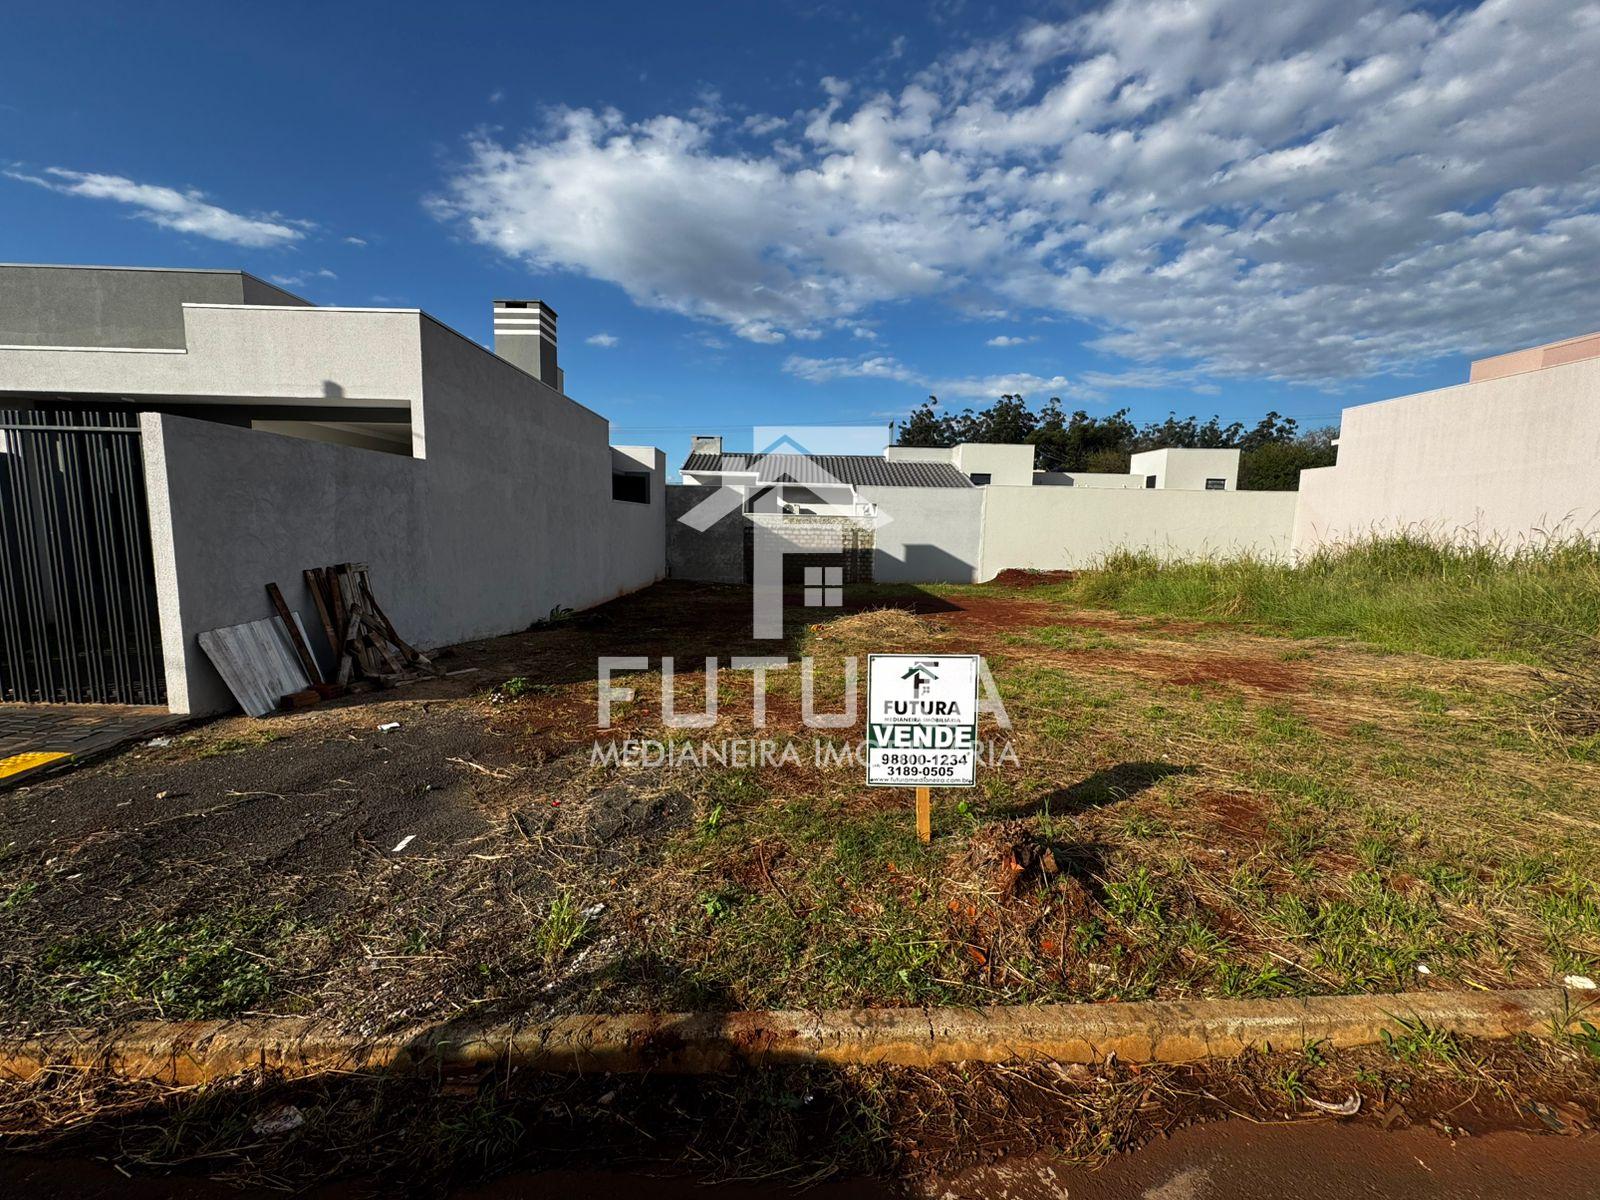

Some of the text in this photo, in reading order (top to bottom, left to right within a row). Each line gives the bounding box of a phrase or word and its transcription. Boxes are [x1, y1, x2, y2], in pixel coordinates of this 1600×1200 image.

[884, 701, 961, 715] FUTURA
[873, 725, 972, 748] VENDE
[881, 754, 968, 766] 98800-1234
[887, 766, 954, 777] 3189-0505
